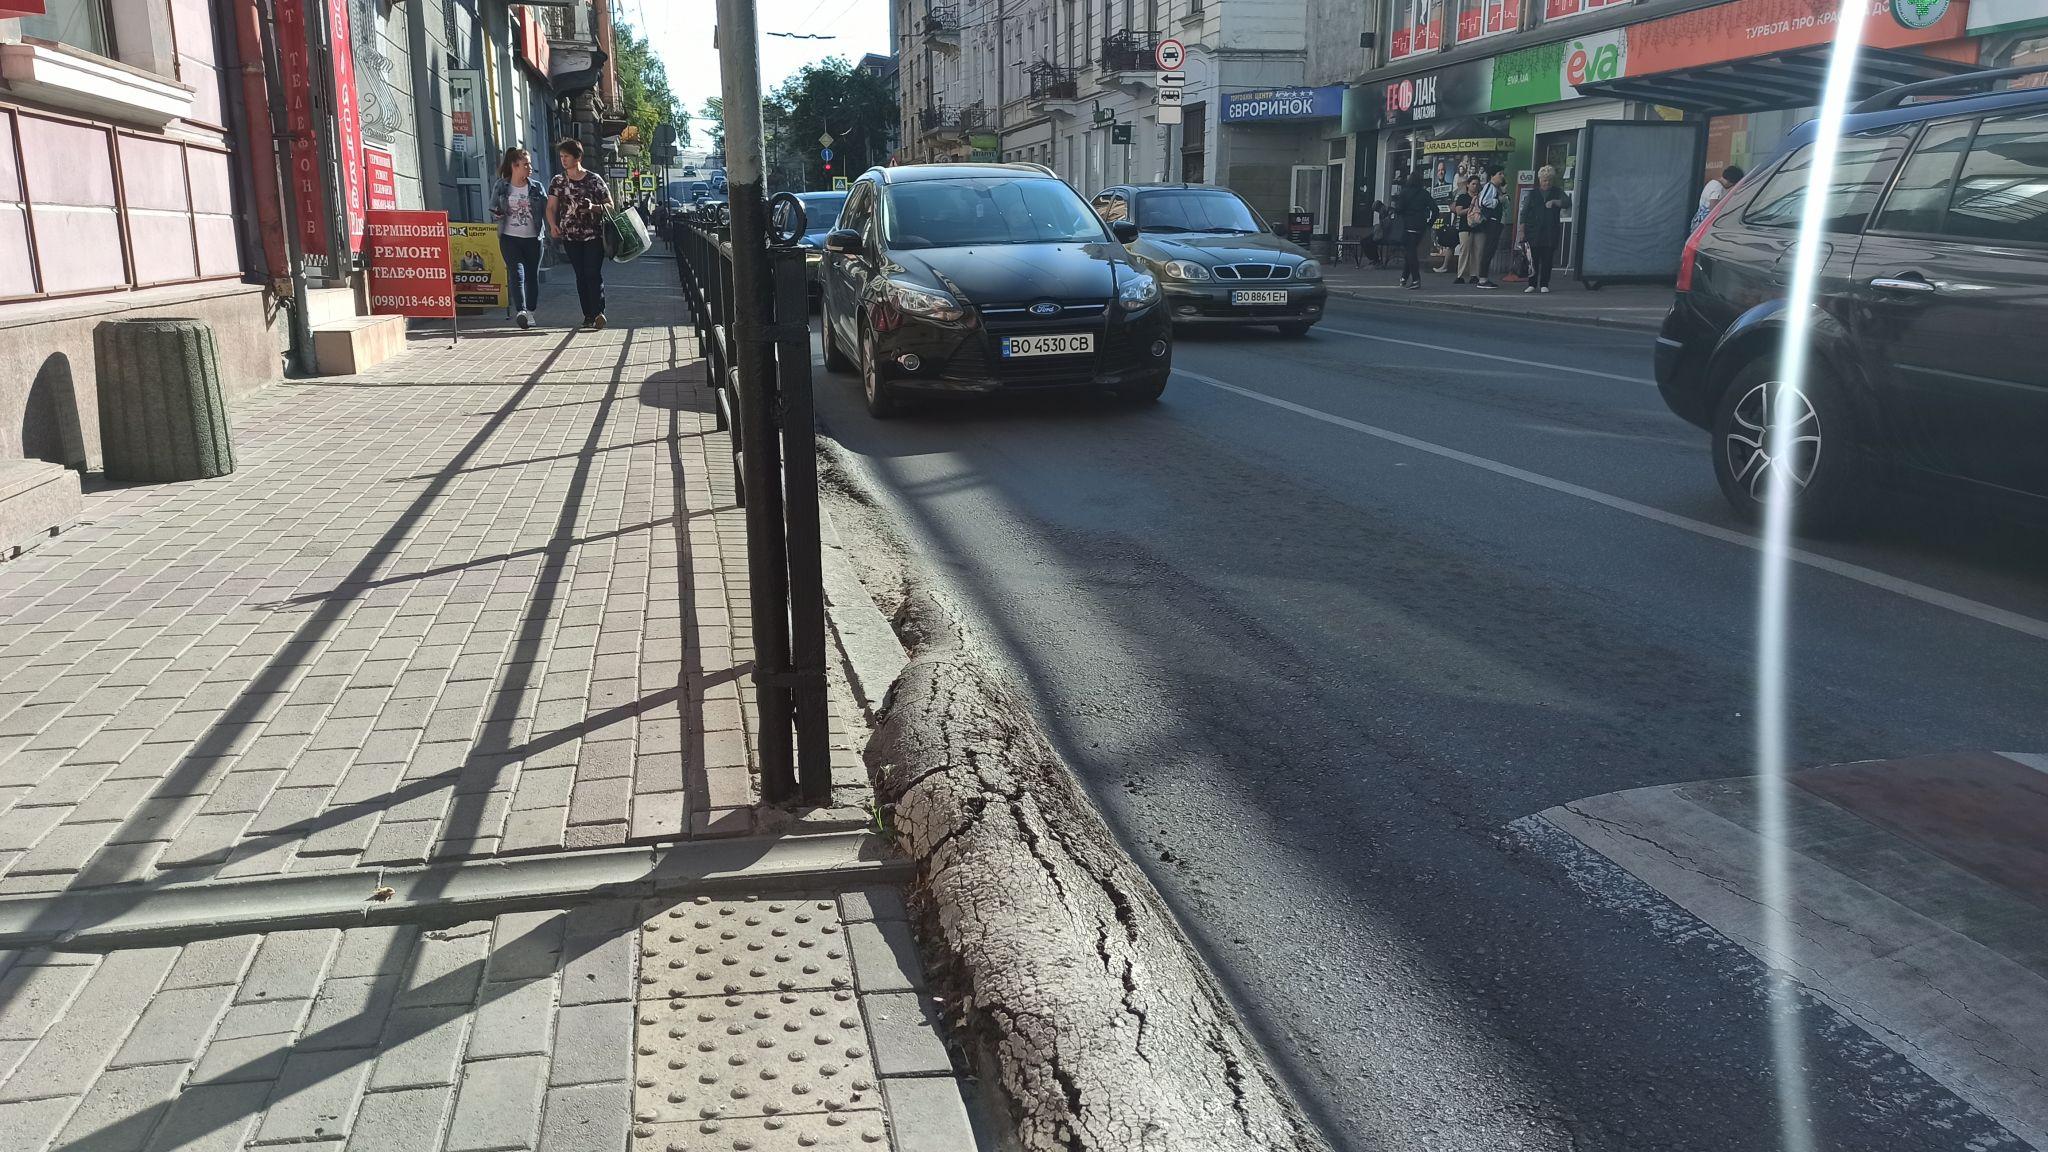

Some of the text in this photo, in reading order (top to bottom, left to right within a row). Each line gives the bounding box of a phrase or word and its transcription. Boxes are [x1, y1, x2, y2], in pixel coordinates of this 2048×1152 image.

[1745, 20, 1790, 39] ТУРБОТА
[1791, 13, 1815, 30] ПРО
[1387, 76, 1437, 112] ГЕЛЬ ЛАК
[1229, 98, 1313, 118] ЄВРОРИНОК
[1413, 104, 1436, 120] МАГАЗИН
[368, 222, 446, 237] ТЕРМІНОВИЙ
[374, 246, 442, 259] РЕМОНТ
[372, 266, 447, 279] ТЕЛЕФОНІВ
[372, 295, 452, 309] (098)018-46-88
[1010, 336, 1089, 354] BO 4530 CB
